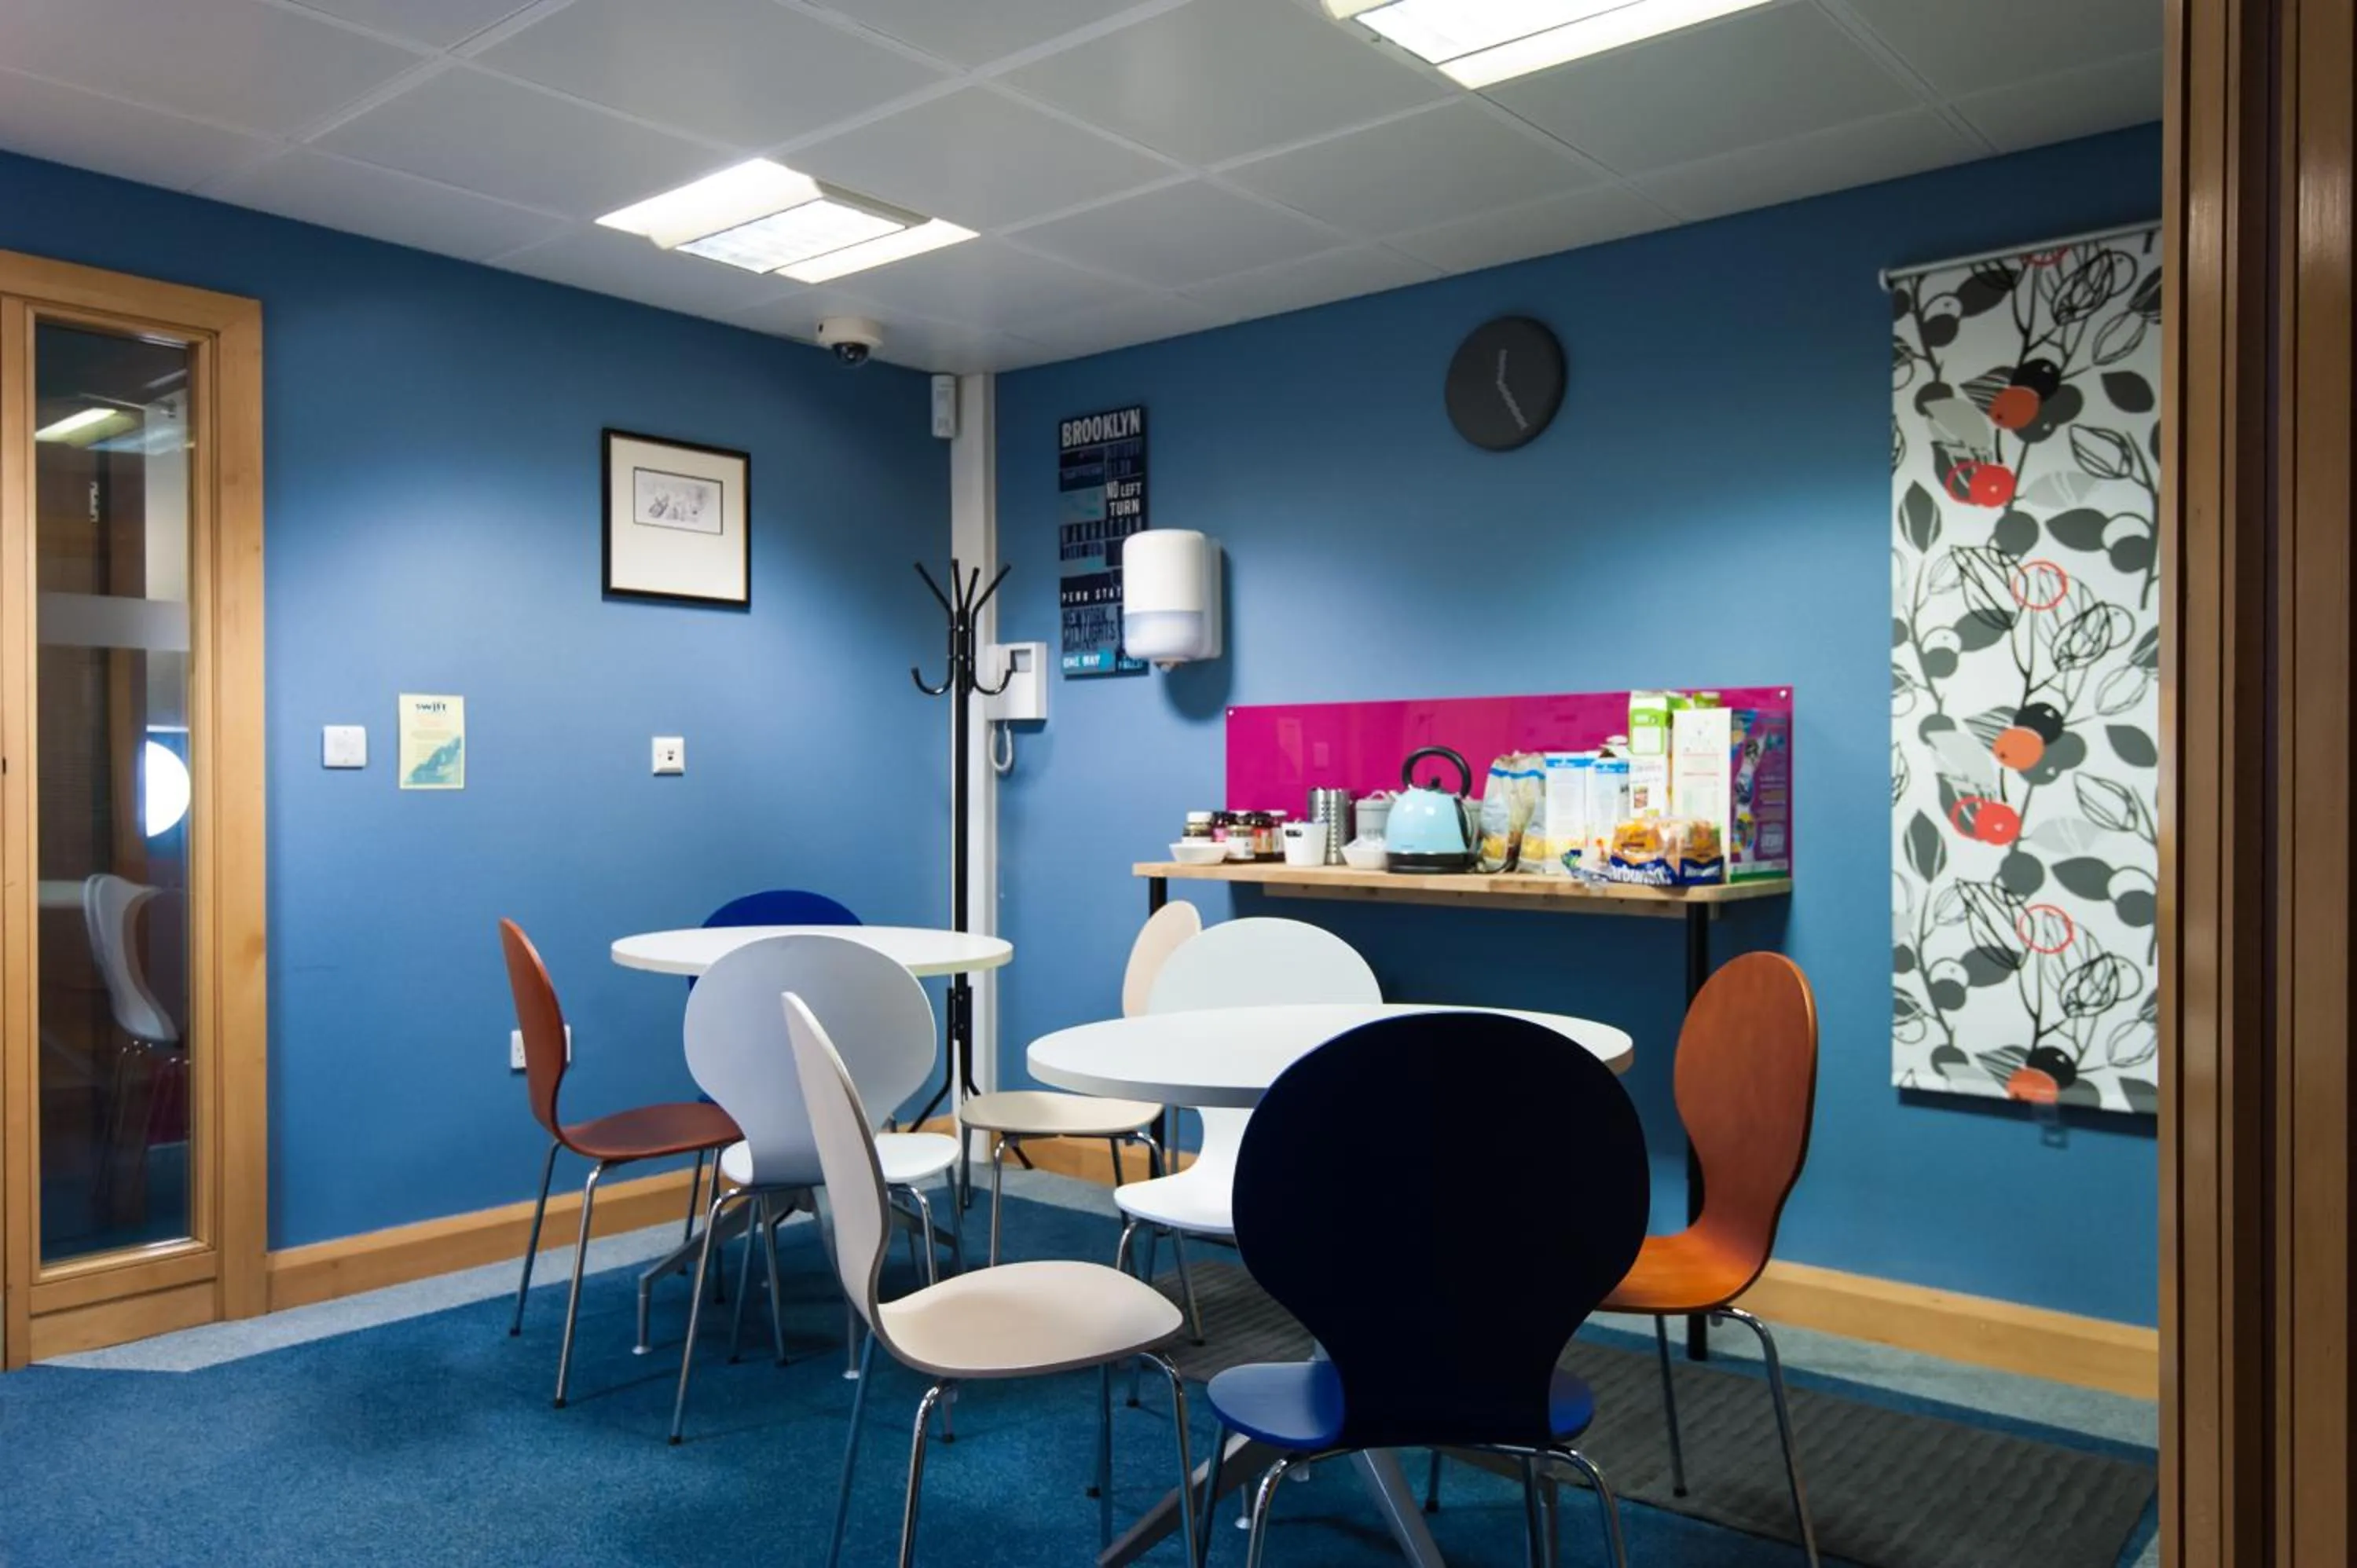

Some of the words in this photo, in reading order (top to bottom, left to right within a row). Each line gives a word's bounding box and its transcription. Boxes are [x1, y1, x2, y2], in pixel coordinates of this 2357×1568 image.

[1061, 408, 1142, 448] BROOKLYN
[1106, 480, 1120, 500] NO
[1120, 482, 1142, 498] LEFT
[1109, 498, 1141, 516] TURN
[1082, 654, 1101, 667] WAY
